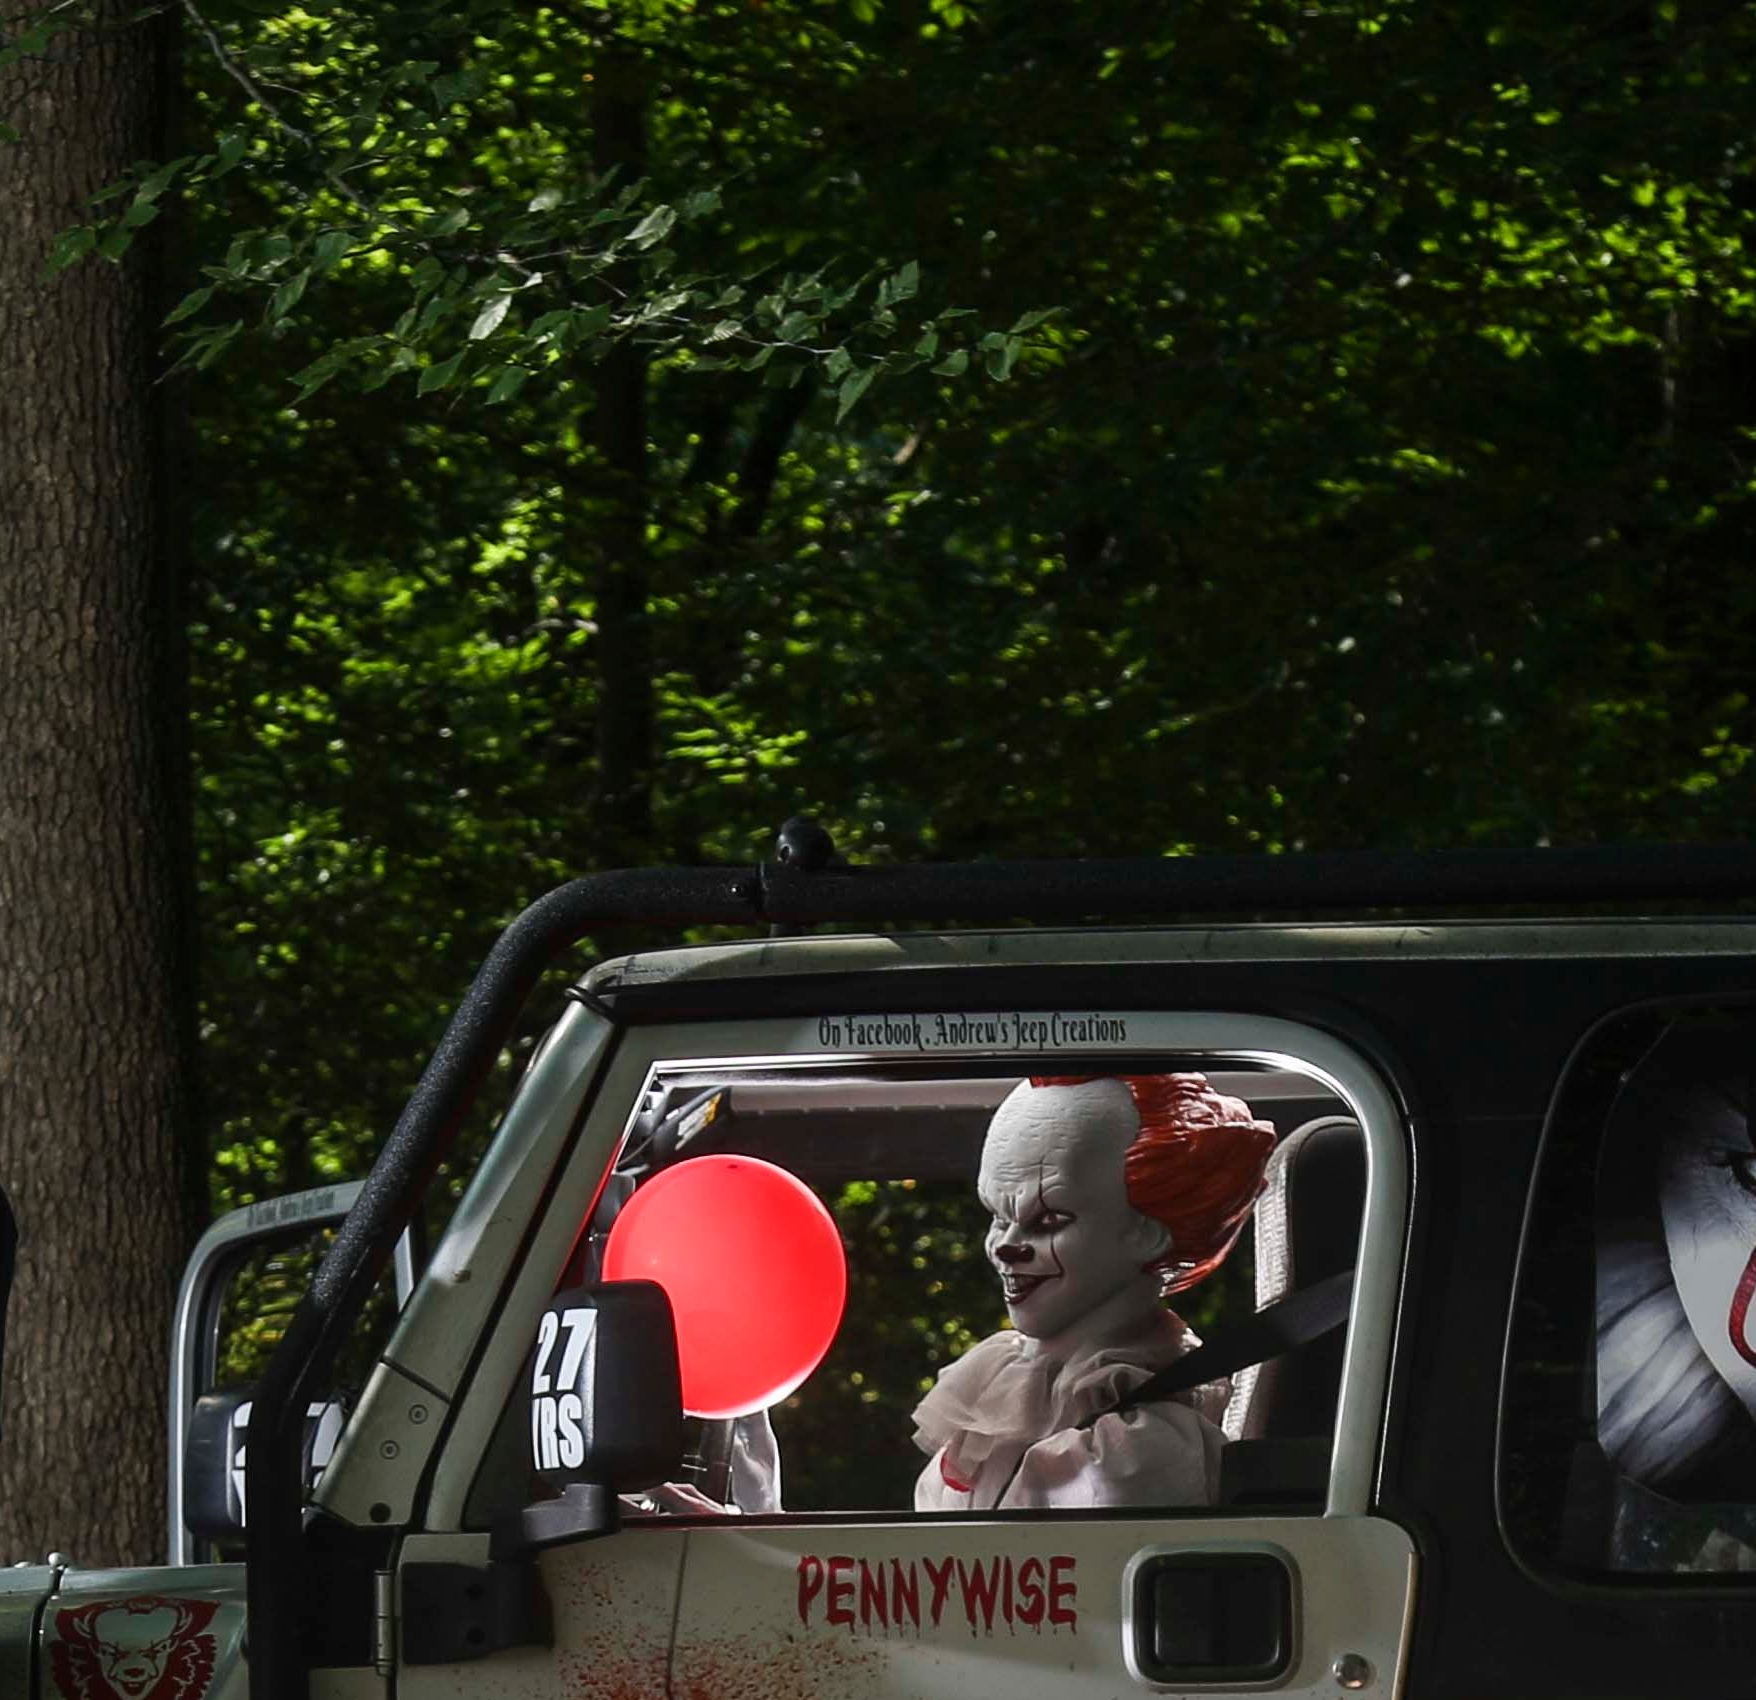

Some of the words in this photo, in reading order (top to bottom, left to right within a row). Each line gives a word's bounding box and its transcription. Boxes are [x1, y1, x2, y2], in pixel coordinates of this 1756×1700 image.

[819, 1015, 841, 1048] On
[933, 1013, 1008, 1046] Andrew's
[1012, 1013, 1046, 1050] Jeep
[1051, 1012, 1126, 1047] Creations
[532, 1308, 598, 1394] 27
[796, 1554, 1078, 1638] PENNYWISE
